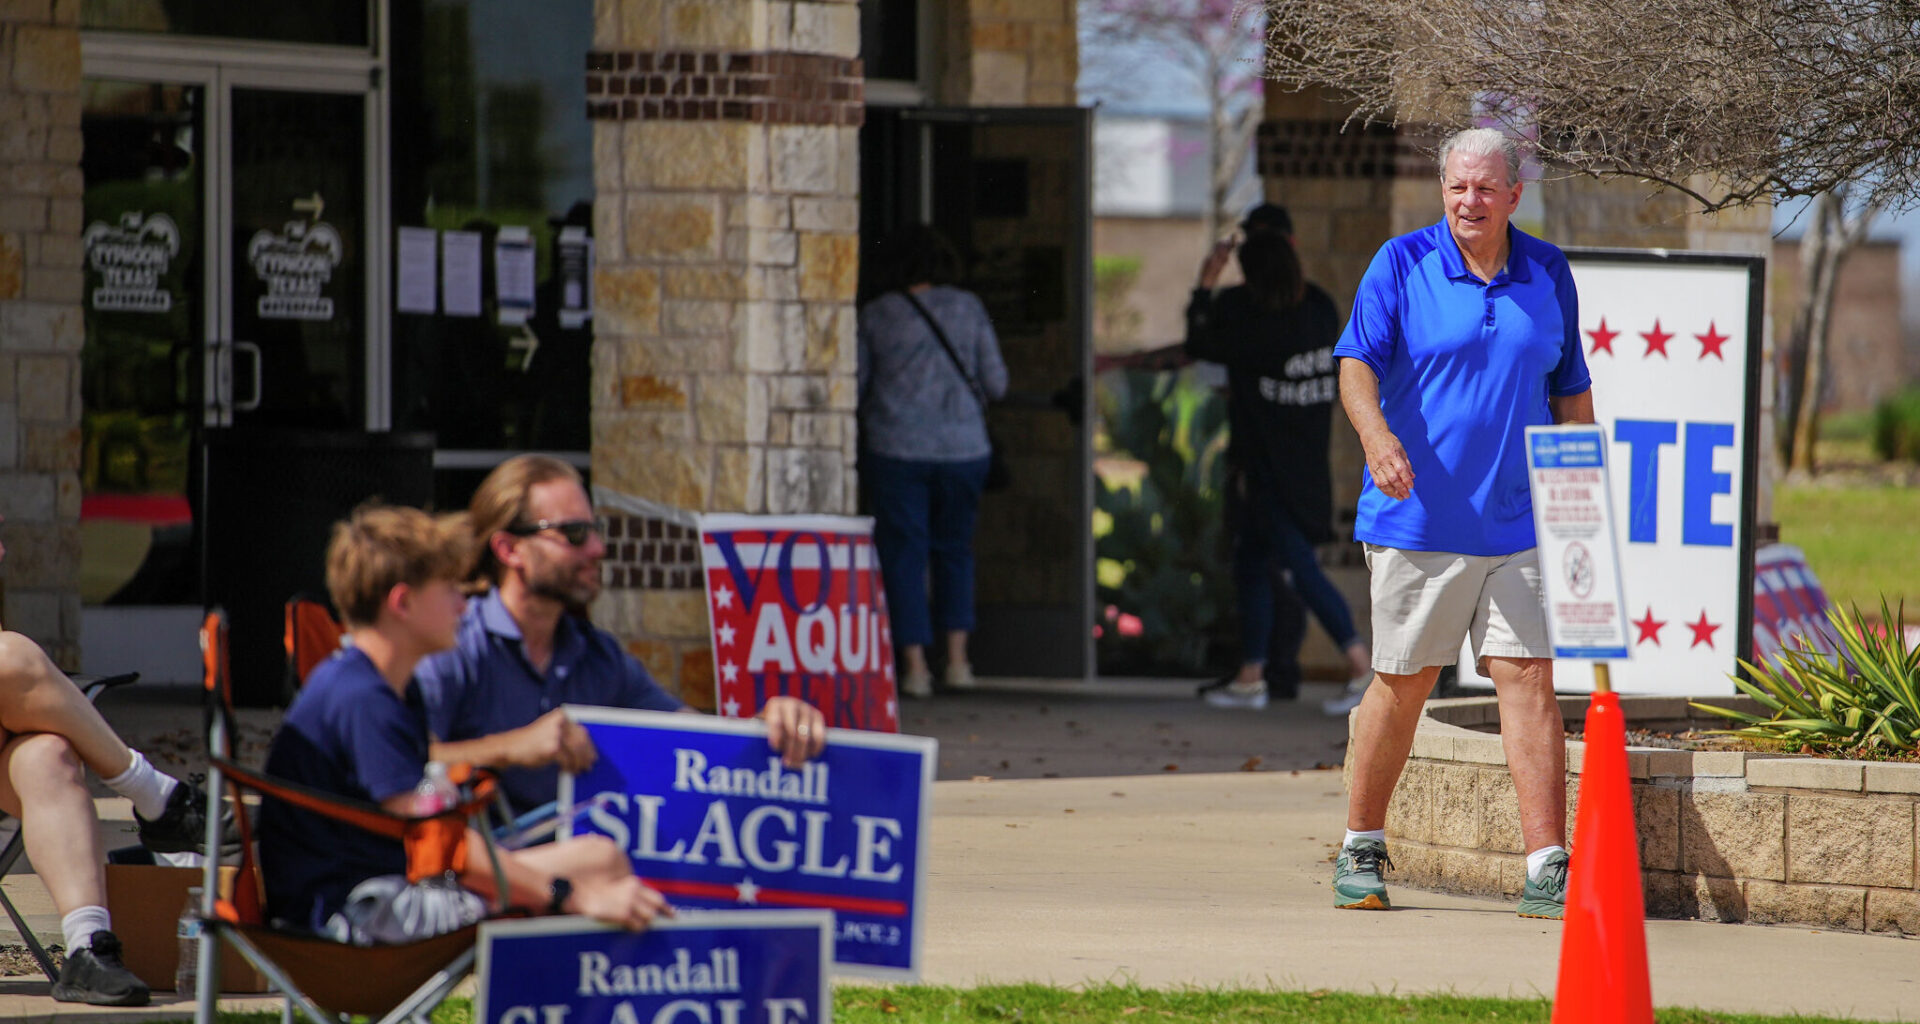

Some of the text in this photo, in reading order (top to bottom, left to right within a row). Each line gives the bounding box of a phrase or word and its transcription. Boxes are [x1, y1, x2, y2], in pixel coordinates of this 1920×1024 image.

[107, 266, 153, 286] TEXAS
[1614, 419, 1735, 548] TE
[747, 602, 881, 678] AQUI
[672, 747, 830, 805] Randall
[587, 791, 905, 884] SLAGLE
[576, 947, 741, 996] Randall
